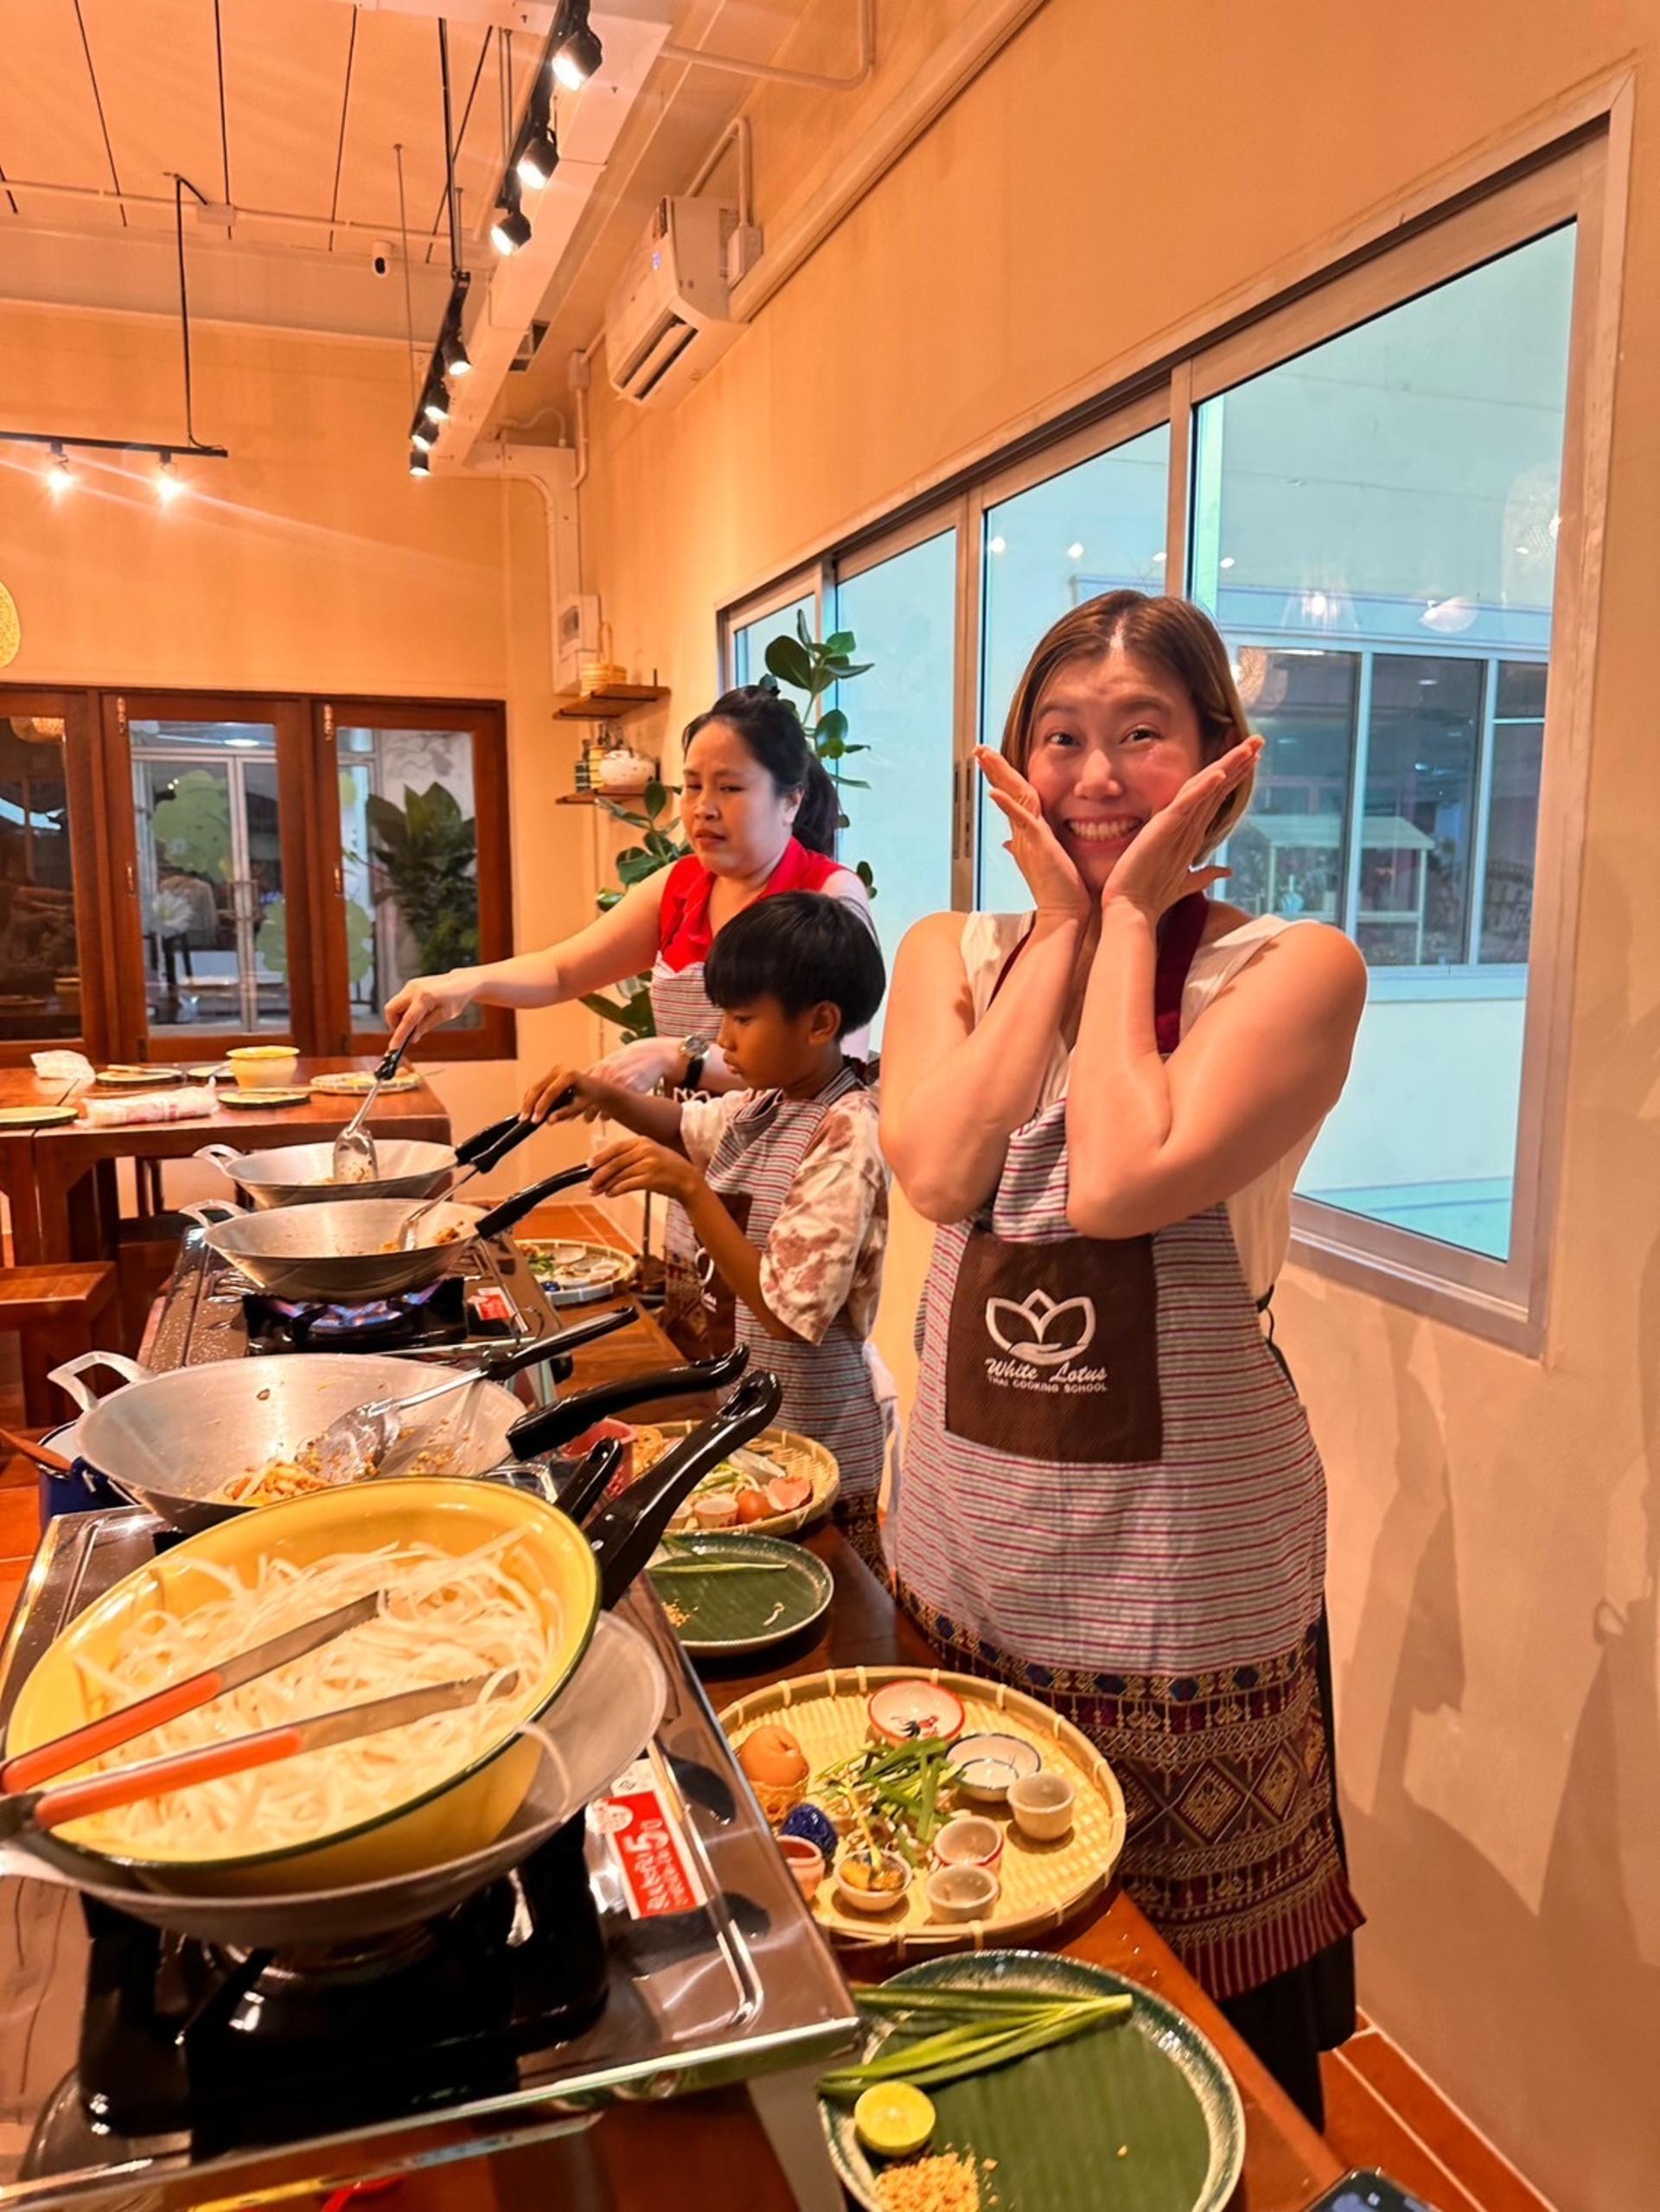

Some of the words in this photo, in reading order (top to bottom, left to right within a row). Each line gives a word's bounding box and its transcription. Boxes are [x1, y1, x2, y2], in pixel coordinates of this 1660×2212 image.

[984, 1358, 1038, 1379] White
[1049, 1361, 1108, 1382] Lotus
[987, 1375, 1010, 1387] THAI
[1012, 1379, 1060, 1393] COOKING
[1063, 1382, 1108, 1394] SCHOOL
